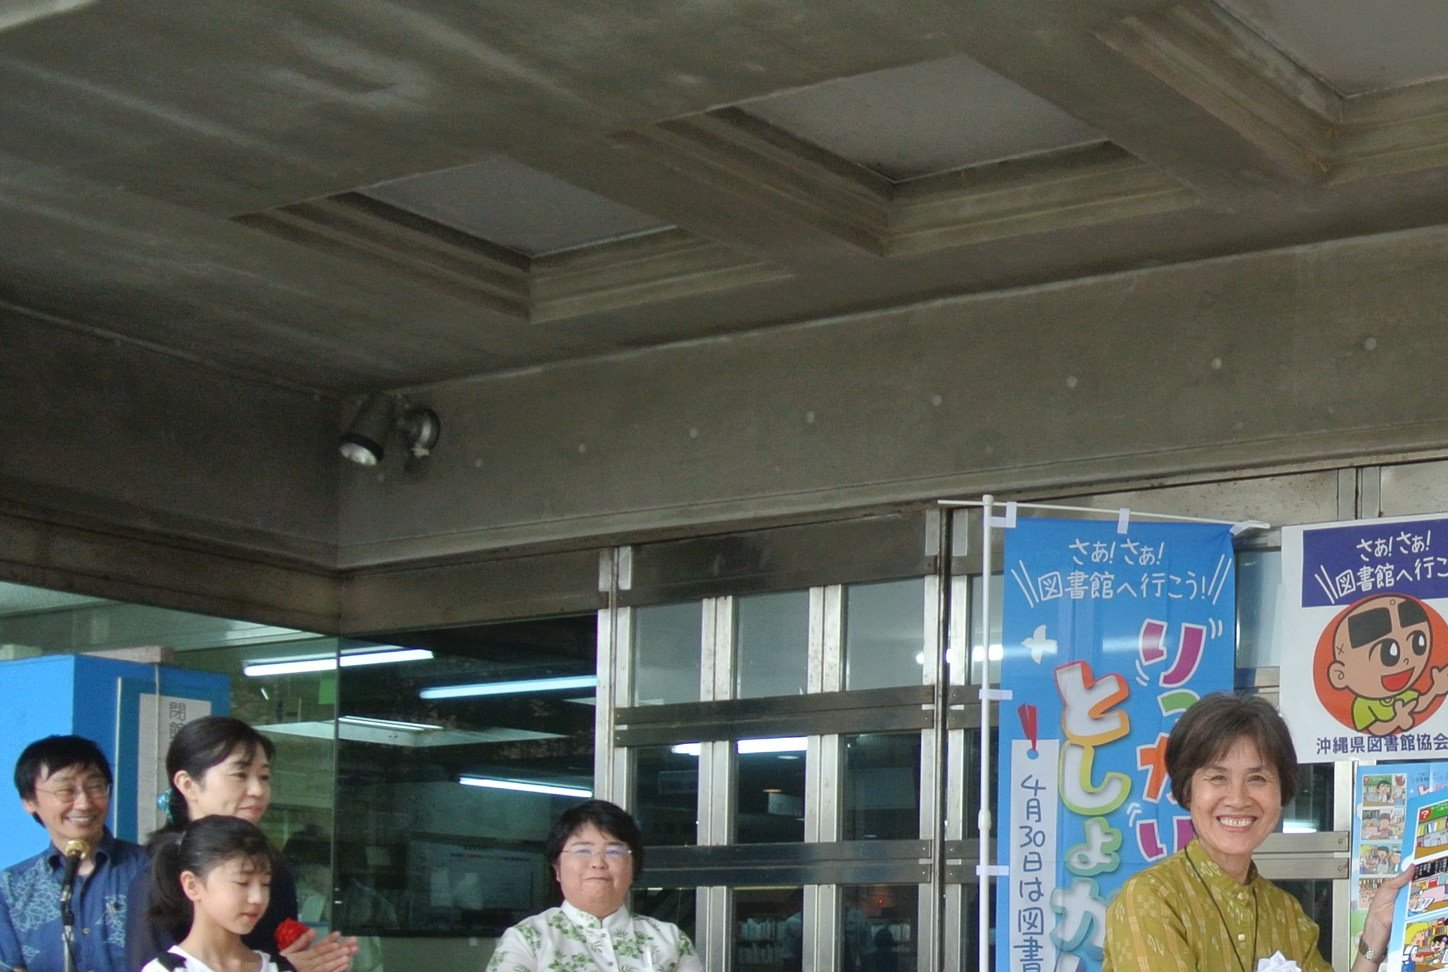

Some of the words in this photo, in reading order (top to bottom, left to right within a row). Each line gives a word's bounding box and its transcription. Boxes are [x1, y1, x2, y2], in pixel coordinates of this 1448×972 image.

[1038, 571, 1206, 601] 図書館へ行こう!
[1316, 732, 1448, 755] 沖縄県図書館協会
